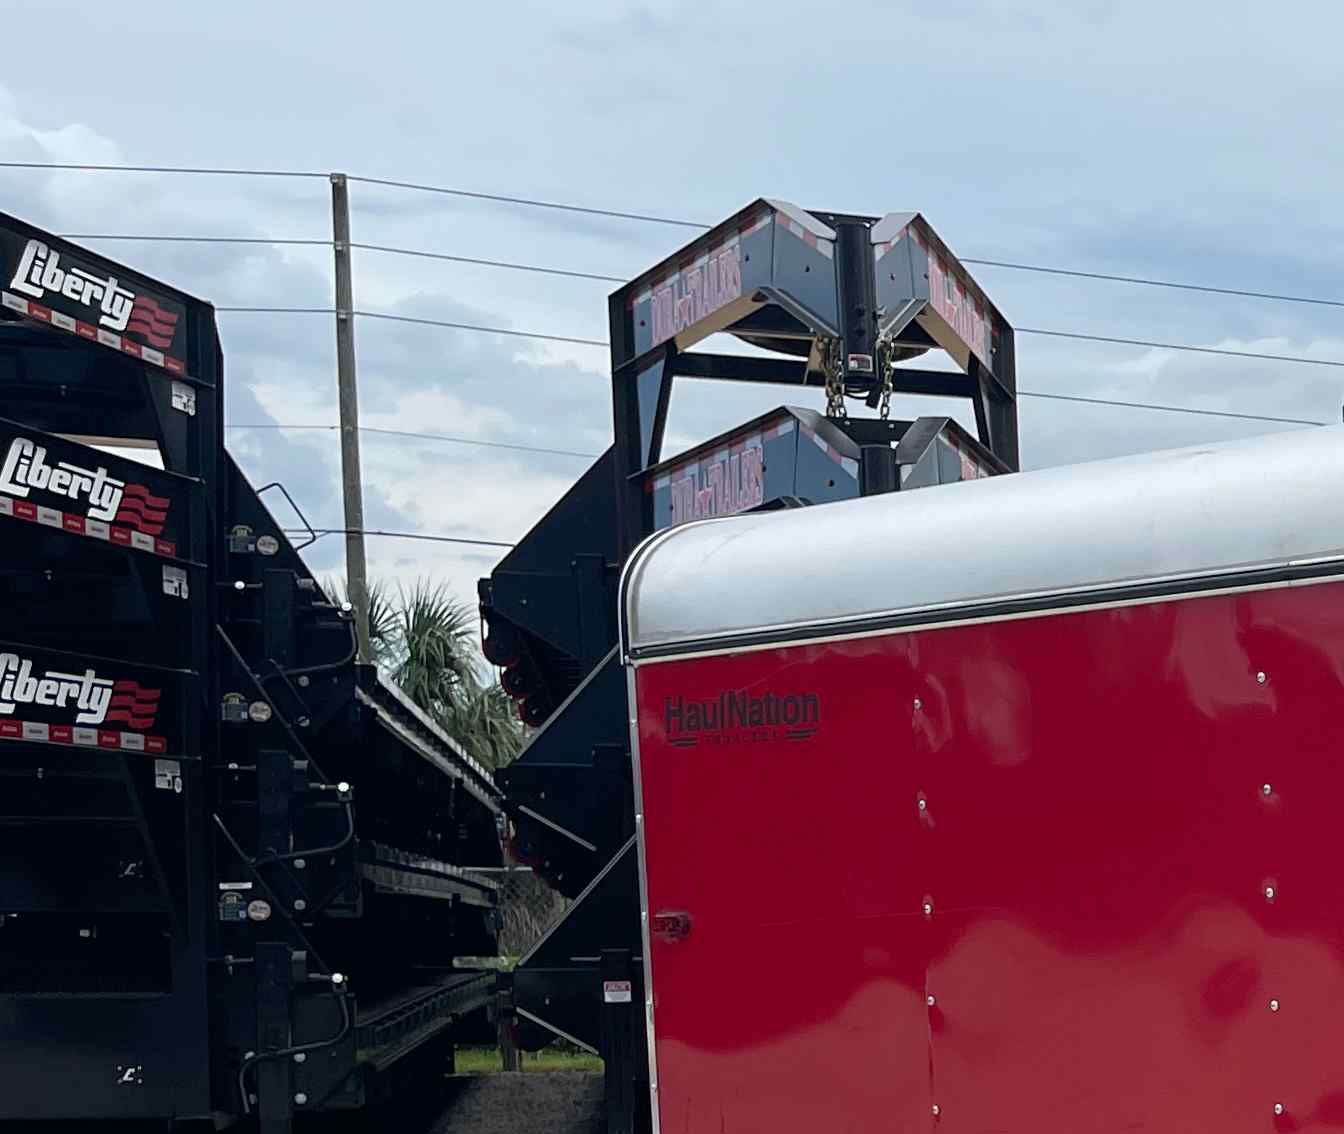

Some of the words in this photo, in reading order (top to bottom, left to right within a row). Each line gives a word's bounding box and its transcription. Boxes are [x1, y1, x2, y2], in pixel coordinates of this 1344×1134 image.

[10, 239, 135, 331] Liberty
[0, 437, 125, 522] Liberty
[664, 689, 820, 734] HaulNation
